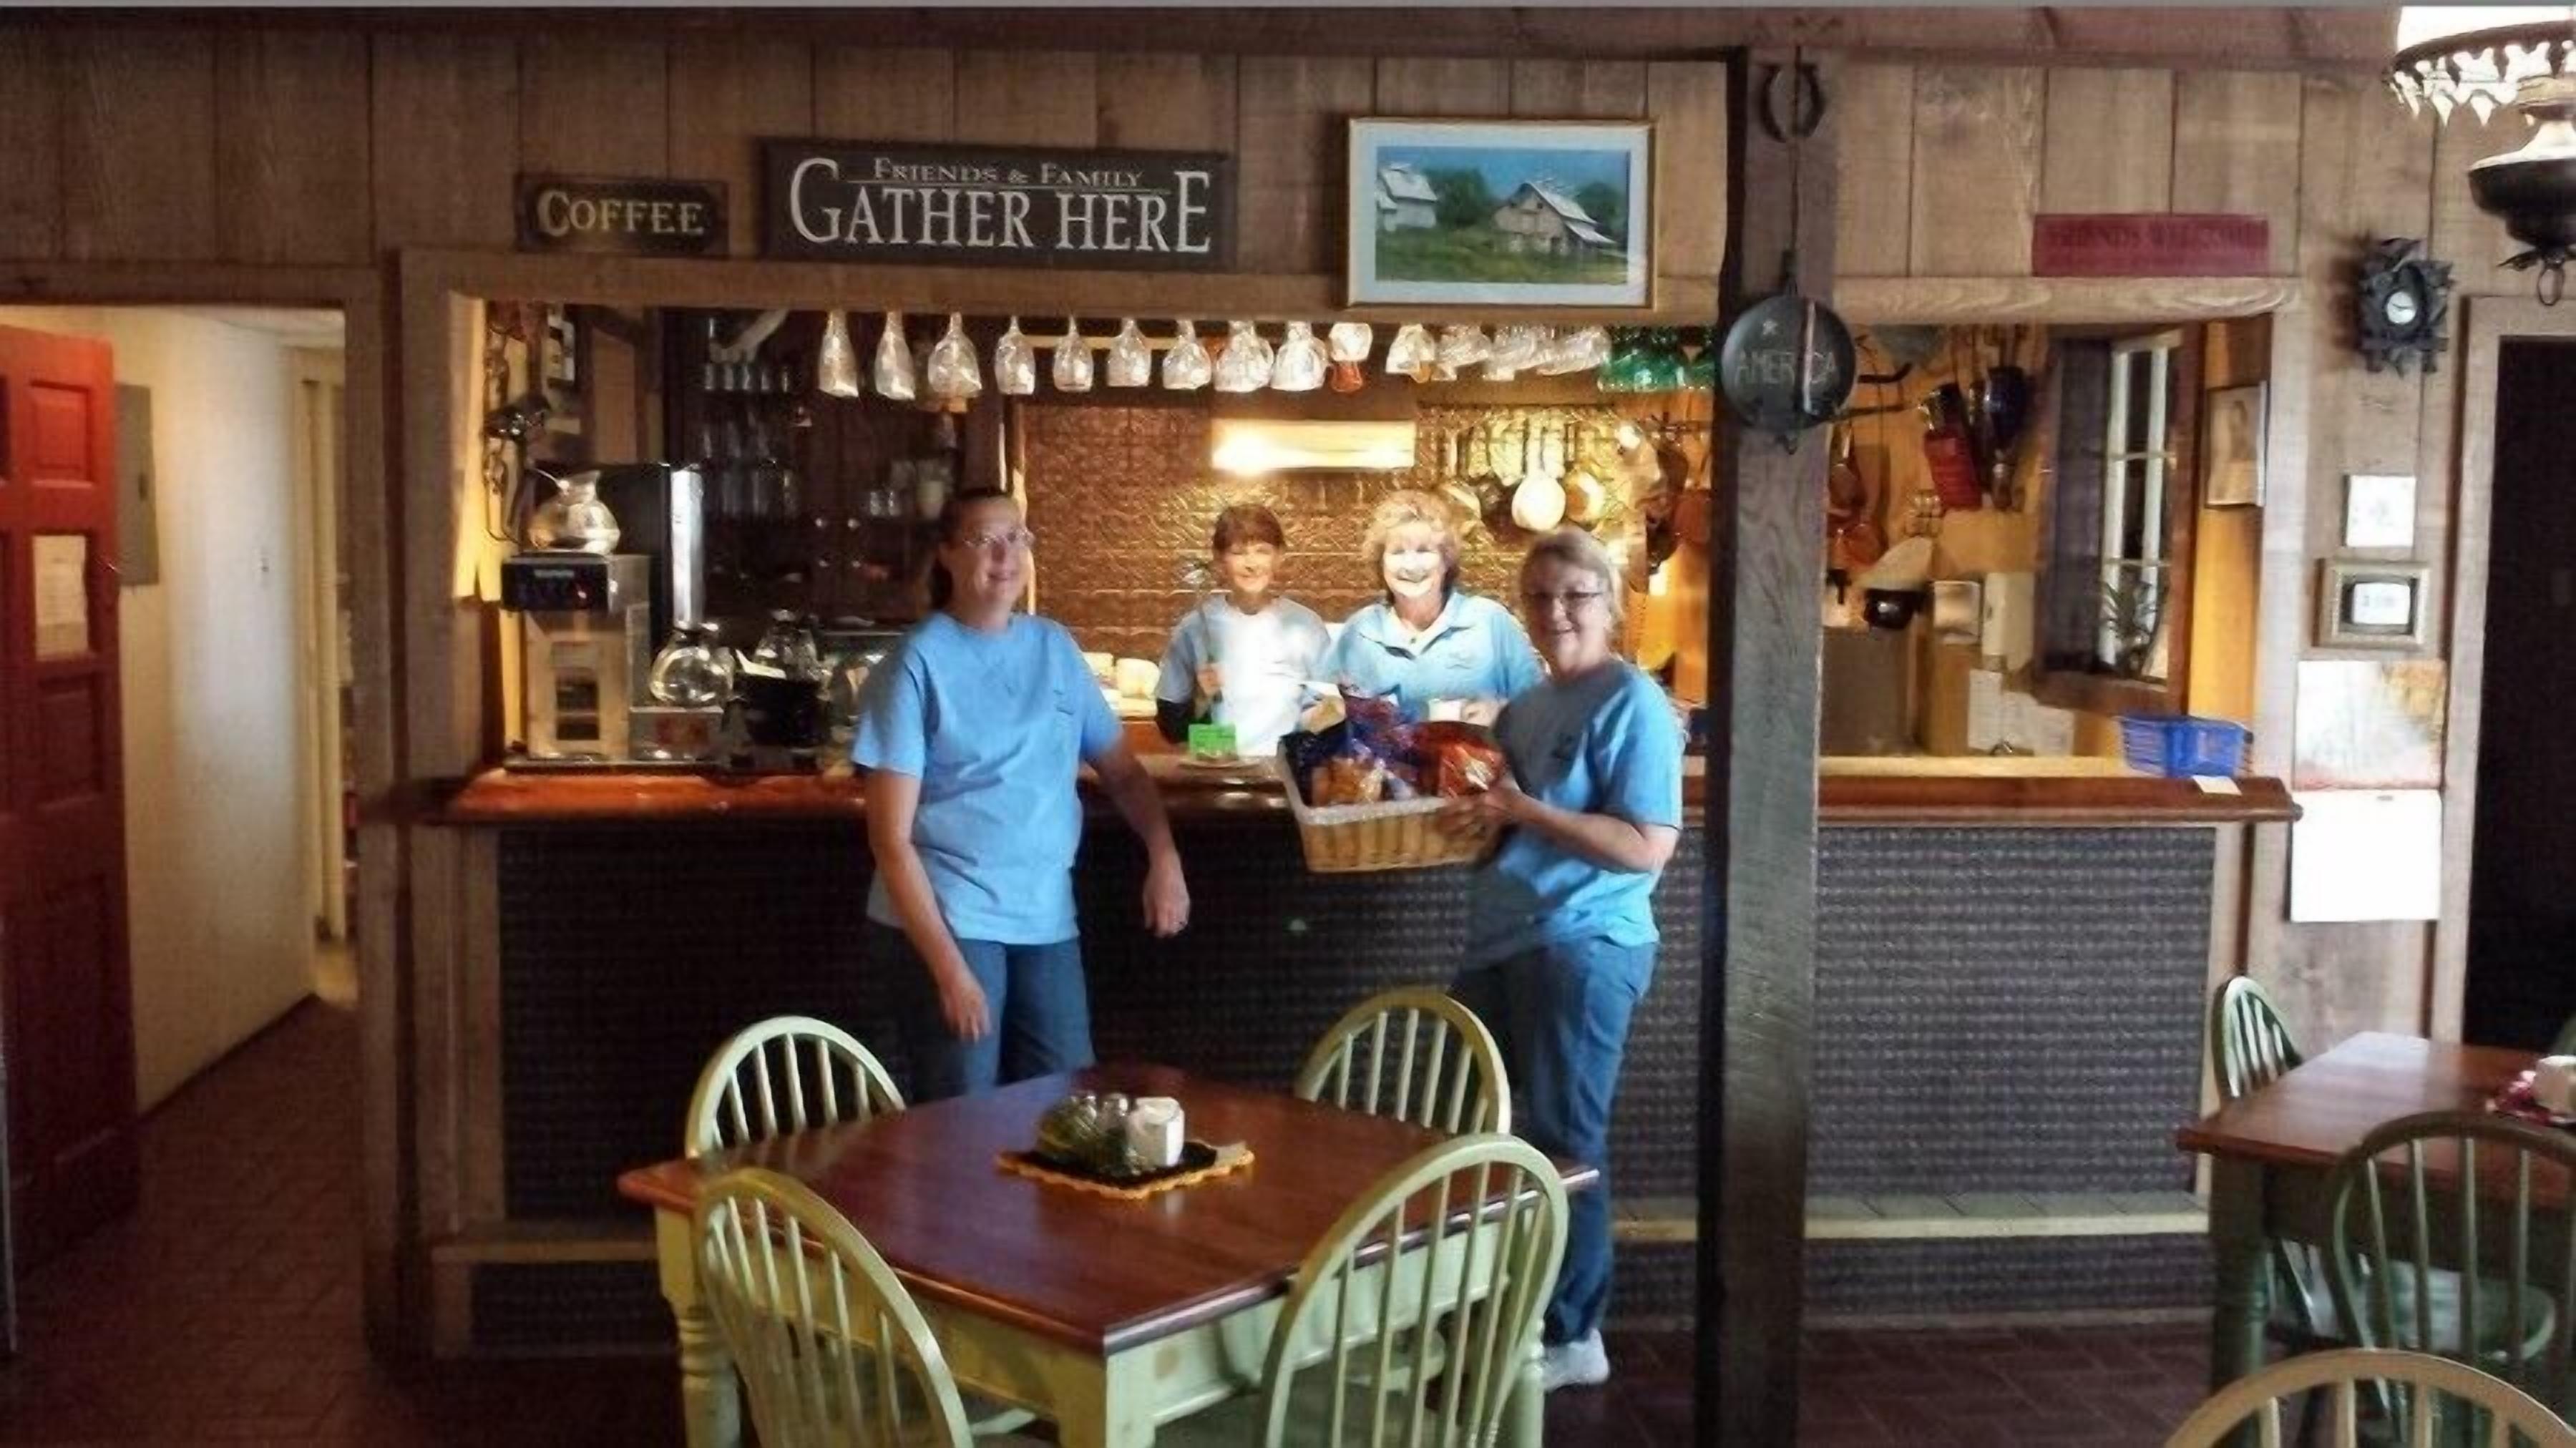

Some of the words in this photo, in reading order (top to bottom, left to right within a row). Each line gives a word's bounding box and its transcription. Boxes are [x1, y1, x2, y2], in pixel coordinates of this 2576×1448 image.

[874, 157, 997, 180] FRIENDS
[1008, 168, 1028, 183] &
[1040, 162, 1143, 187] FAMILY
[538, 190, 705, 237] COFFEE
[790, 157, 1035, 248] GATHER
[1055, 170, 1211, 253] HERE
[1735, 348, 1836, 386] AMERCA
